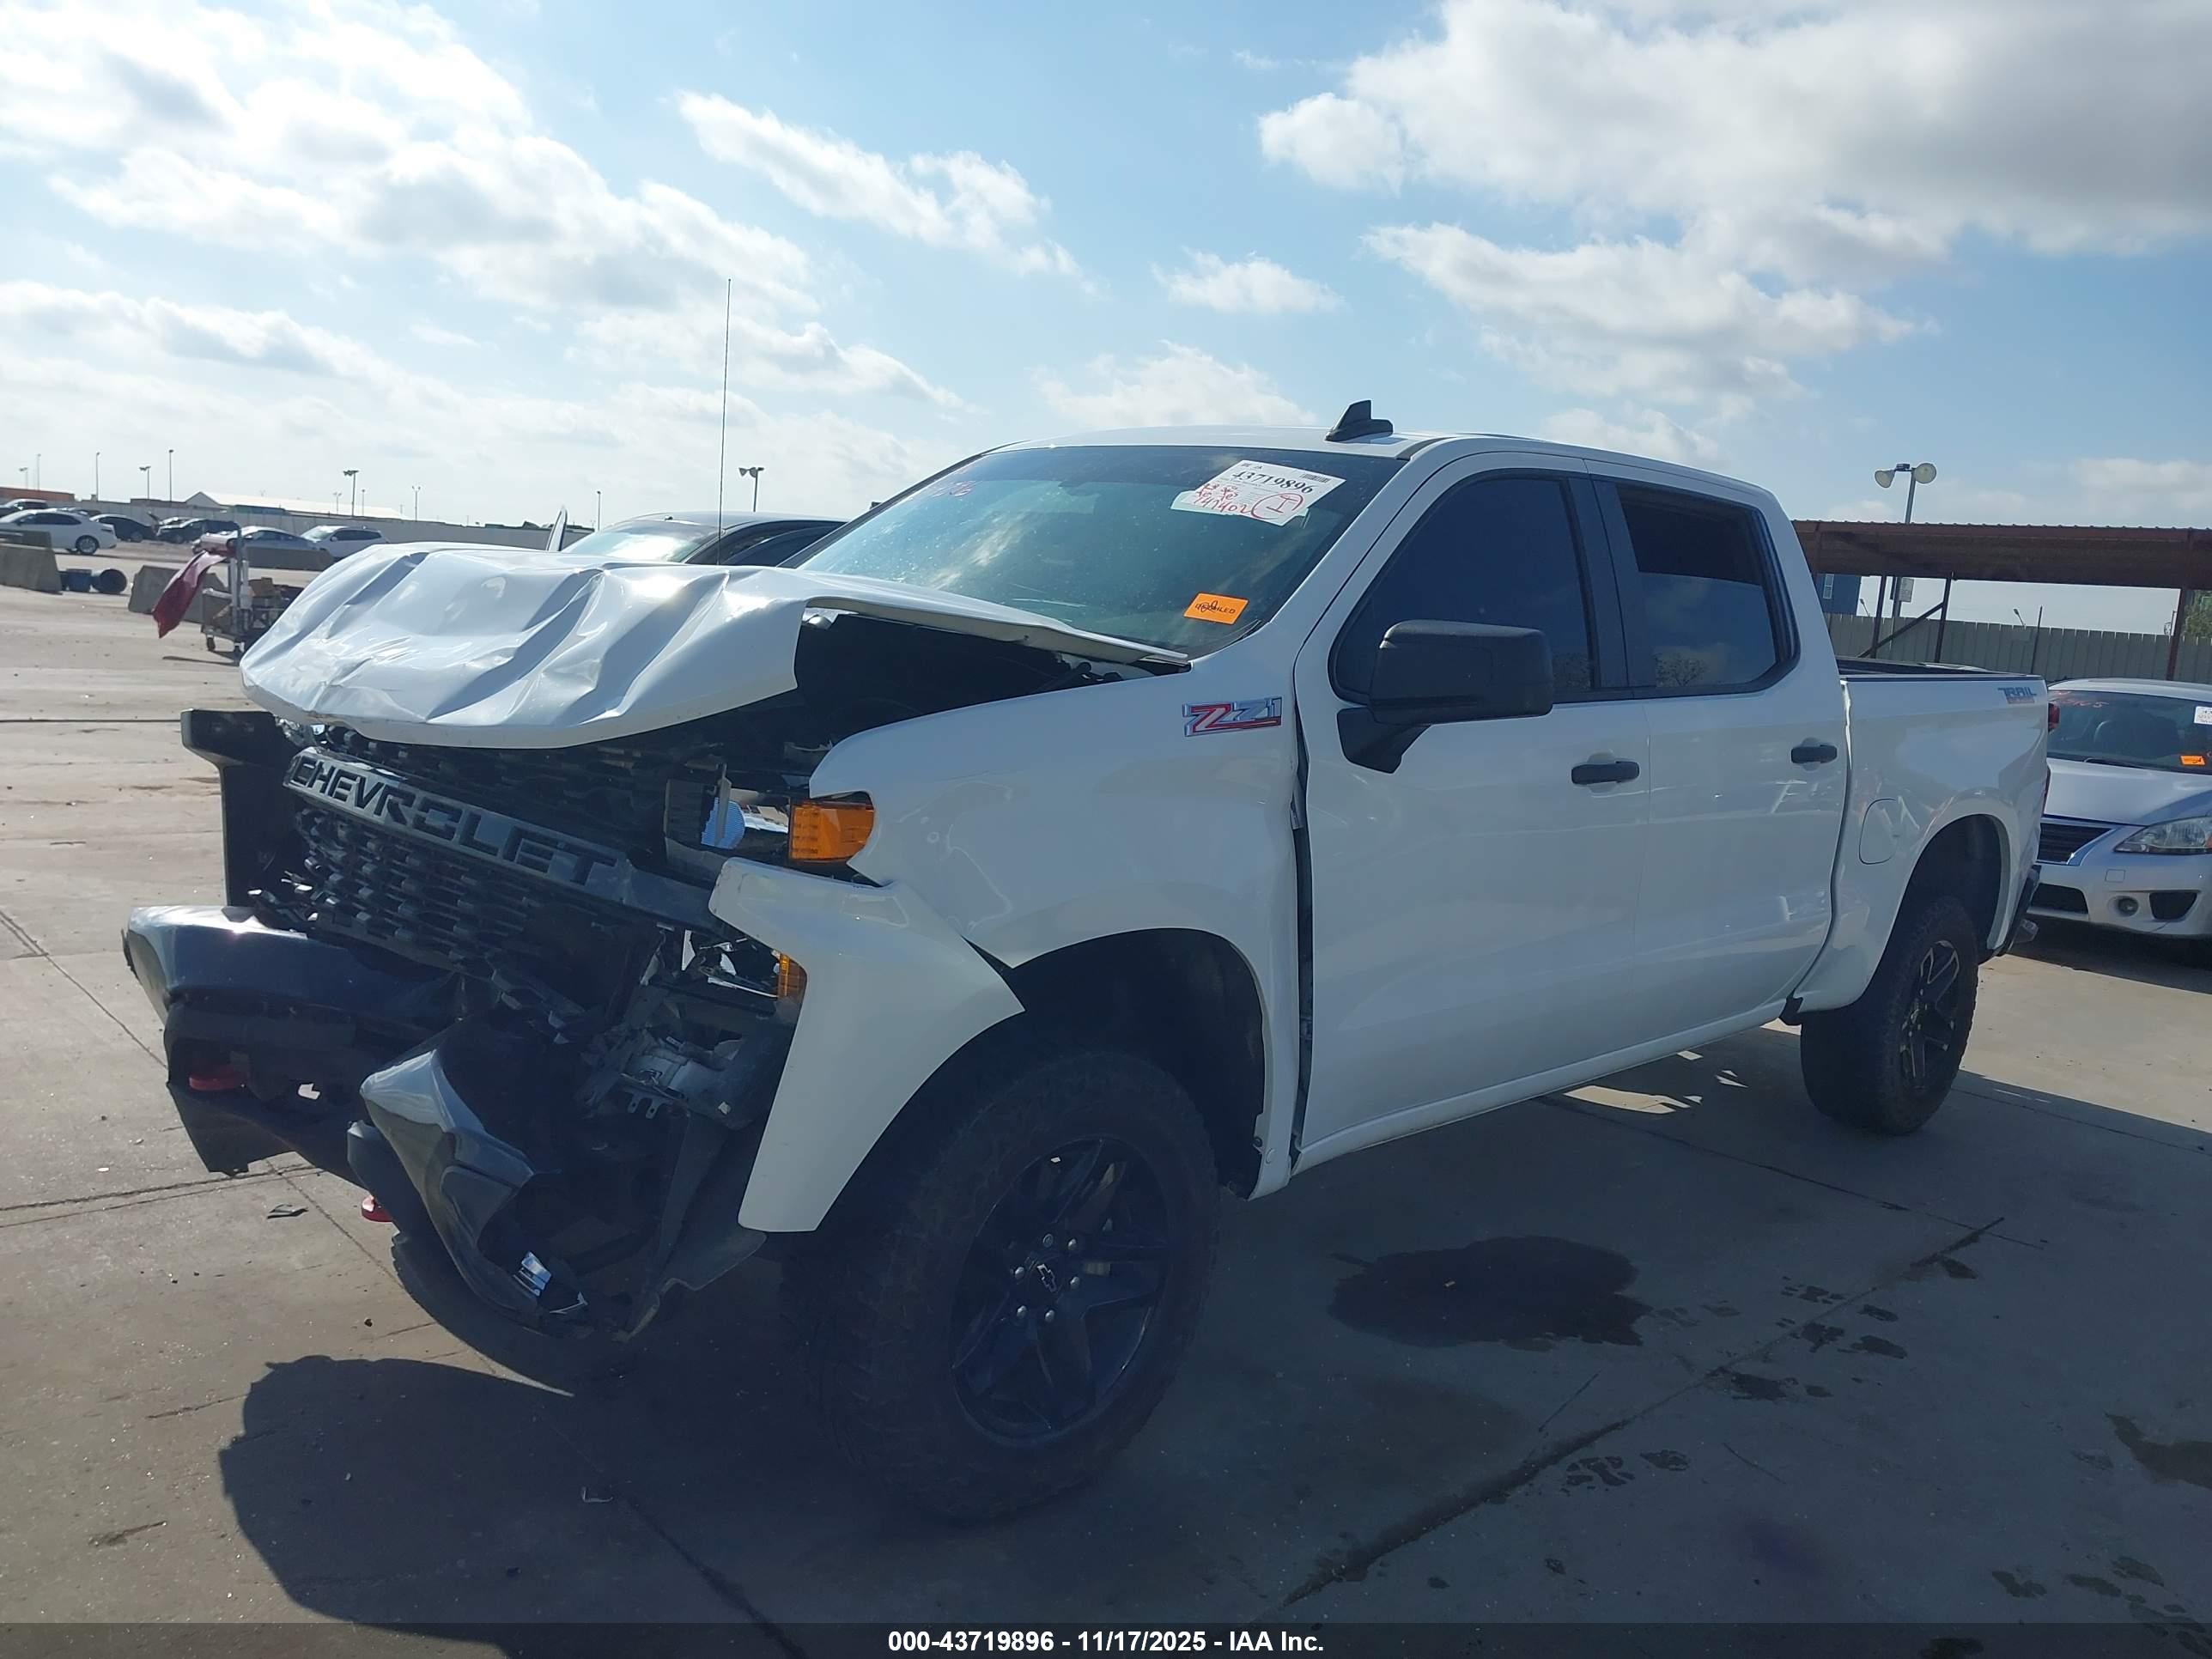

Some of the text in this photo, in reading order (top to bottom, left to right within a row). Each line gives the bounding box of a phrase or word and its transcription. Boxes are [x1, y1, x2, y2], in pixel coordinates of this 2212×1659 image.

[1232, 471, 1315, 494] 43719896
[1997, 687, 2037, 696] TRAIL
[1182, 696, 1282, 737] Z71
[288, 755, 618, 885] CHEVROLET
